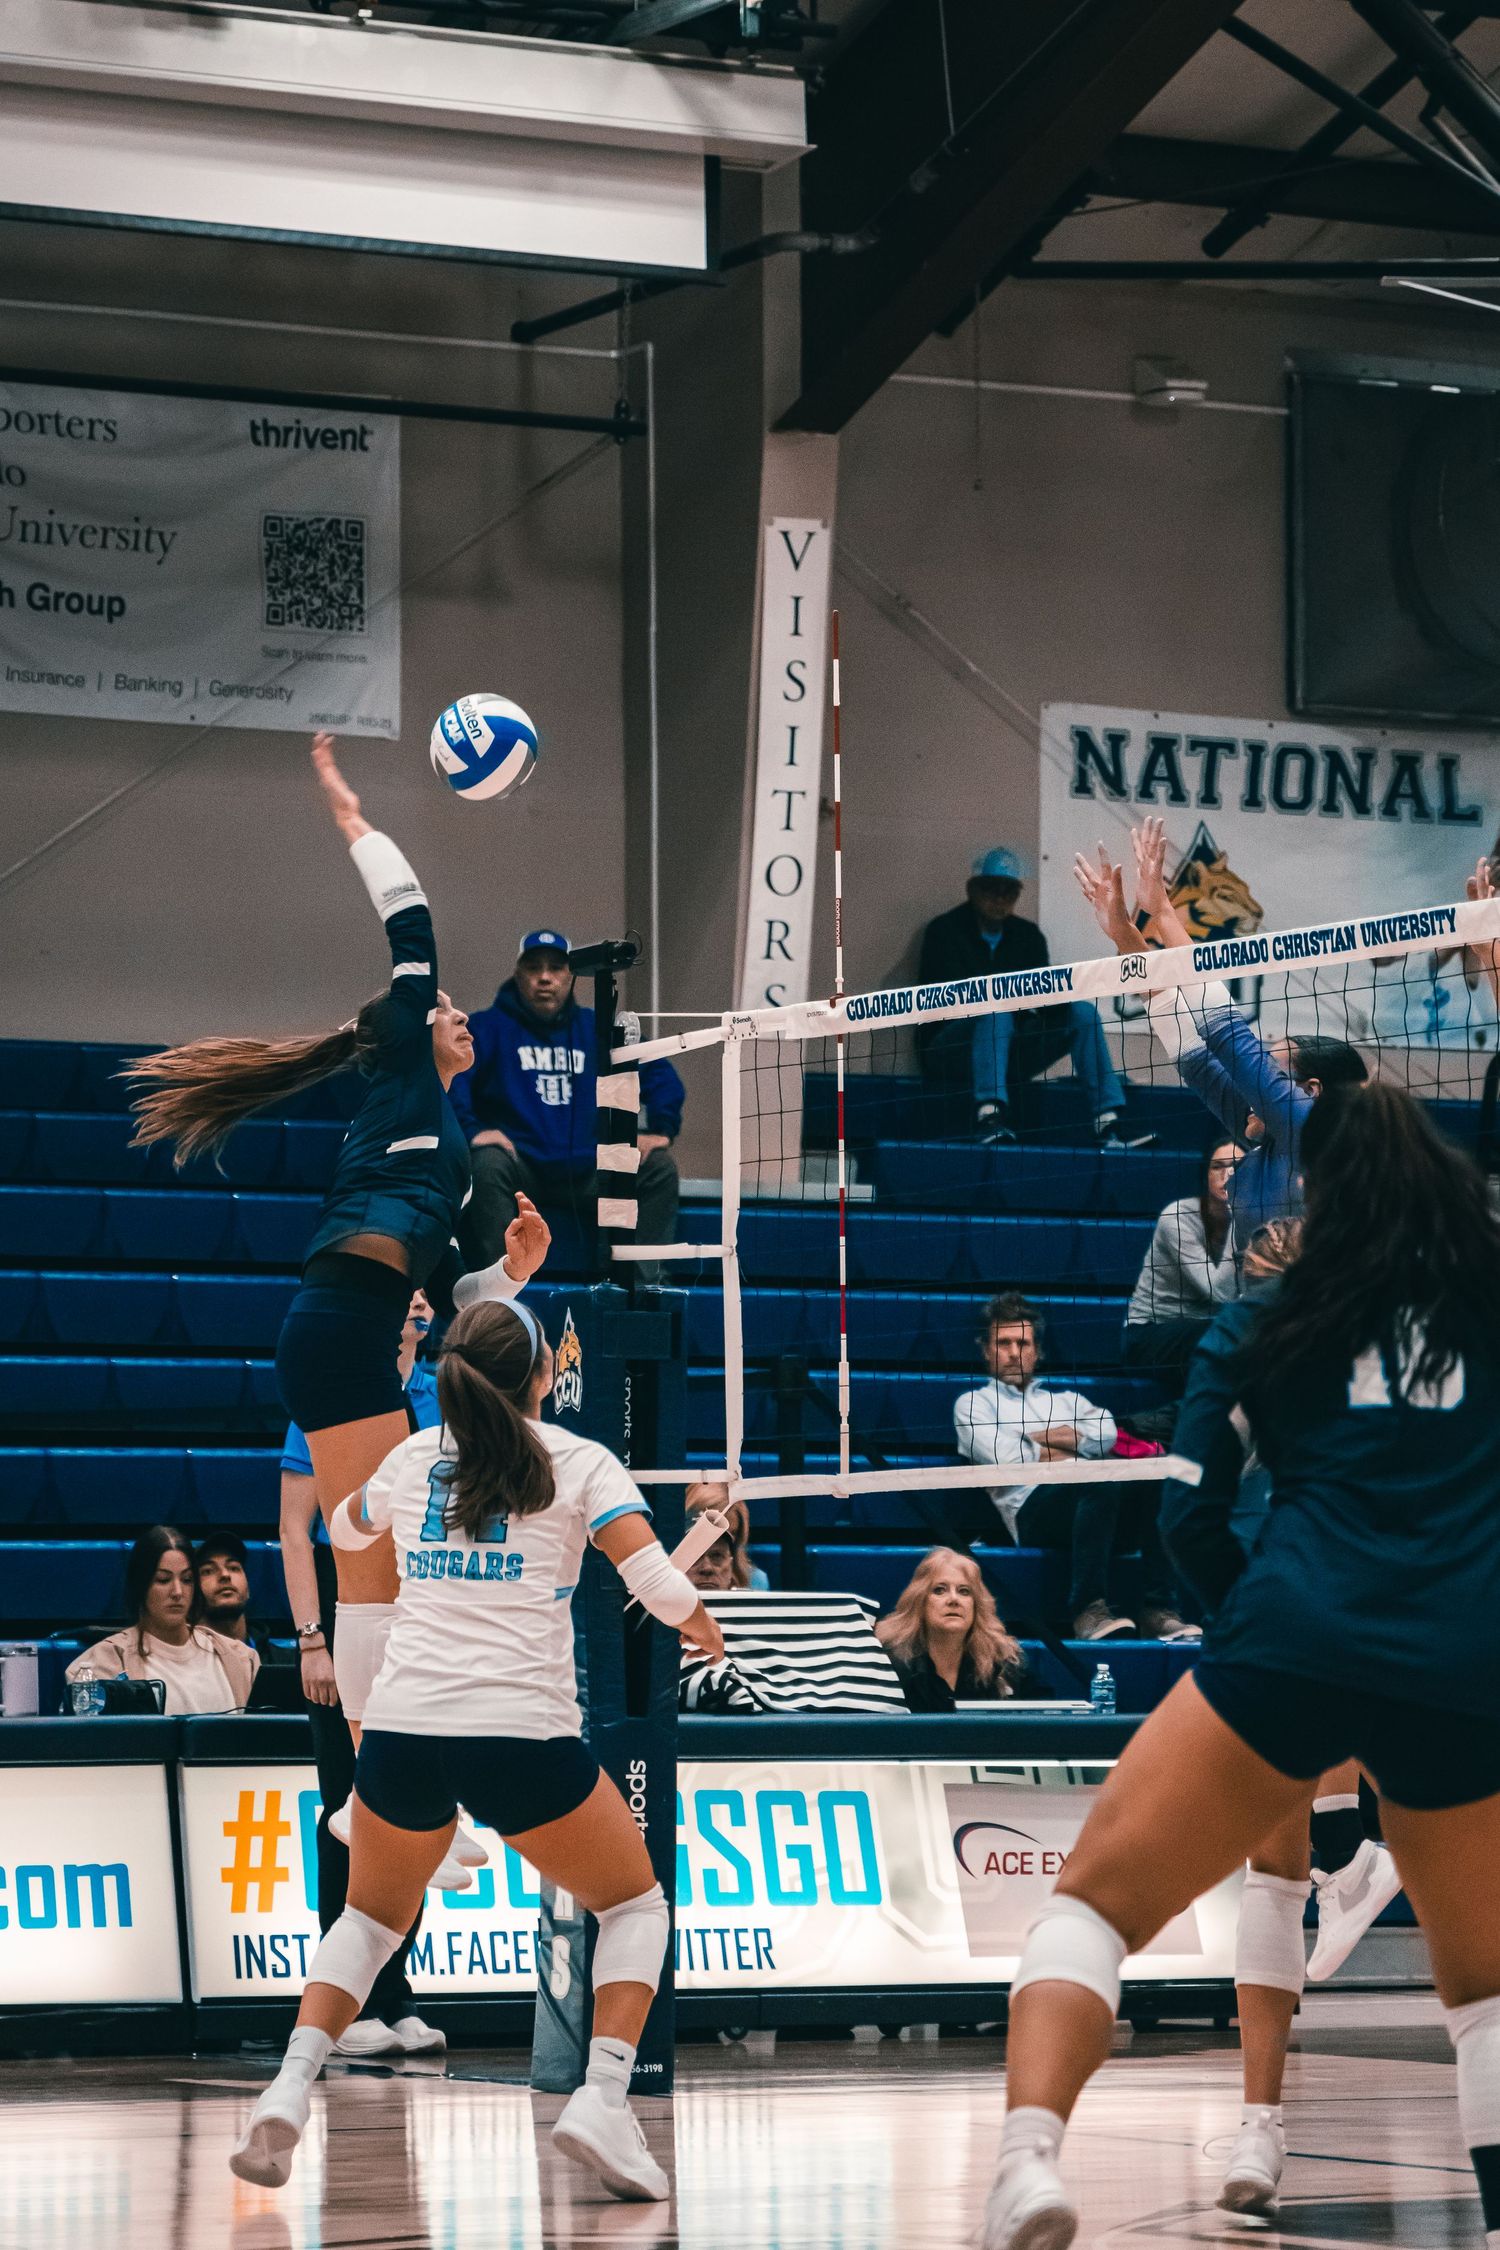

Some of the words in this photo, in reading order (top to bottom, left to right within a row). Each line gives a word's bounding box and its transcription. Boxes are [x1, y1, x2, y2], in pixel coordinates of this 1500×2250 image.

[249, 418, 370, 452] thrivent
[26, 581, 126, 624] Group
[6, 665, 86, 689] Insurance
[114, 672, 183, 698] Banking
[209, 679, 294, 703] Generosity
[1069, 724, 1484, 827] NATIONAL
[1193, 937, 1269, 972] COLORADO
[1272, 925, 1357, 962] CHRISTIAN
[1360, 907, 1456, 948] UNIVERSITY
[1120, 955, 1147, 983] CCU
[846, 990, 913, 1022] COLORADO
[916, 978, 988, 1012] CHRISTIAN
[991, 967, 1074, 1000] UNIVERSITY
[553, 1369, 582, 1415] CCU
[406, 1549, 524, 1582] COUGARS
[625, 1759, 648, 1843] sport
[984, 1851, 1034, 1876] ACE
[1042, 1851, 1072, 1876] EX
[0, 1863, 133, 1930] om
